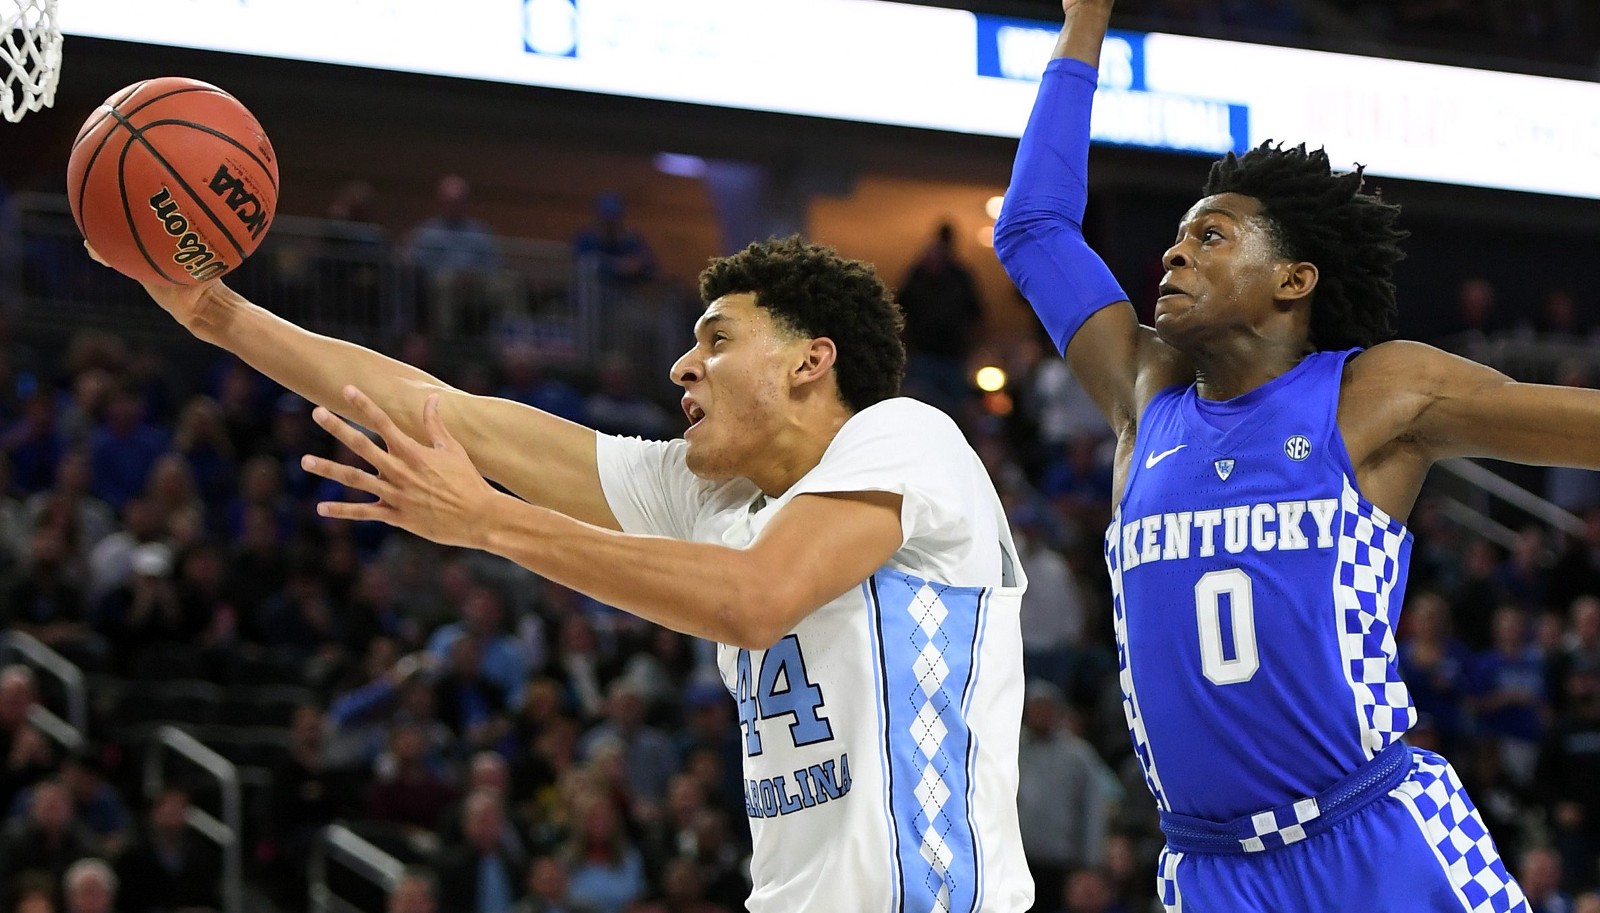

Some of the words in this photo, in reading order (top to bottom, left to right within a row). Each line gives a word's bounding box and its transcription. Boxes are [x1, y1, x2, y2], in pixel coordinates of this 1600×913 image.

[148, 186, 229, 281] Wilson
[207, 163, 269, 241] NCAA
[1285, 437, 1311, 460] SEC
[1122, 498, 1338, 572] KENTUCKY
[1194, 567, 1260, 686] 0
[736, 634, 835, 757] 44
[744, 753, 852, 818] AROLINA
